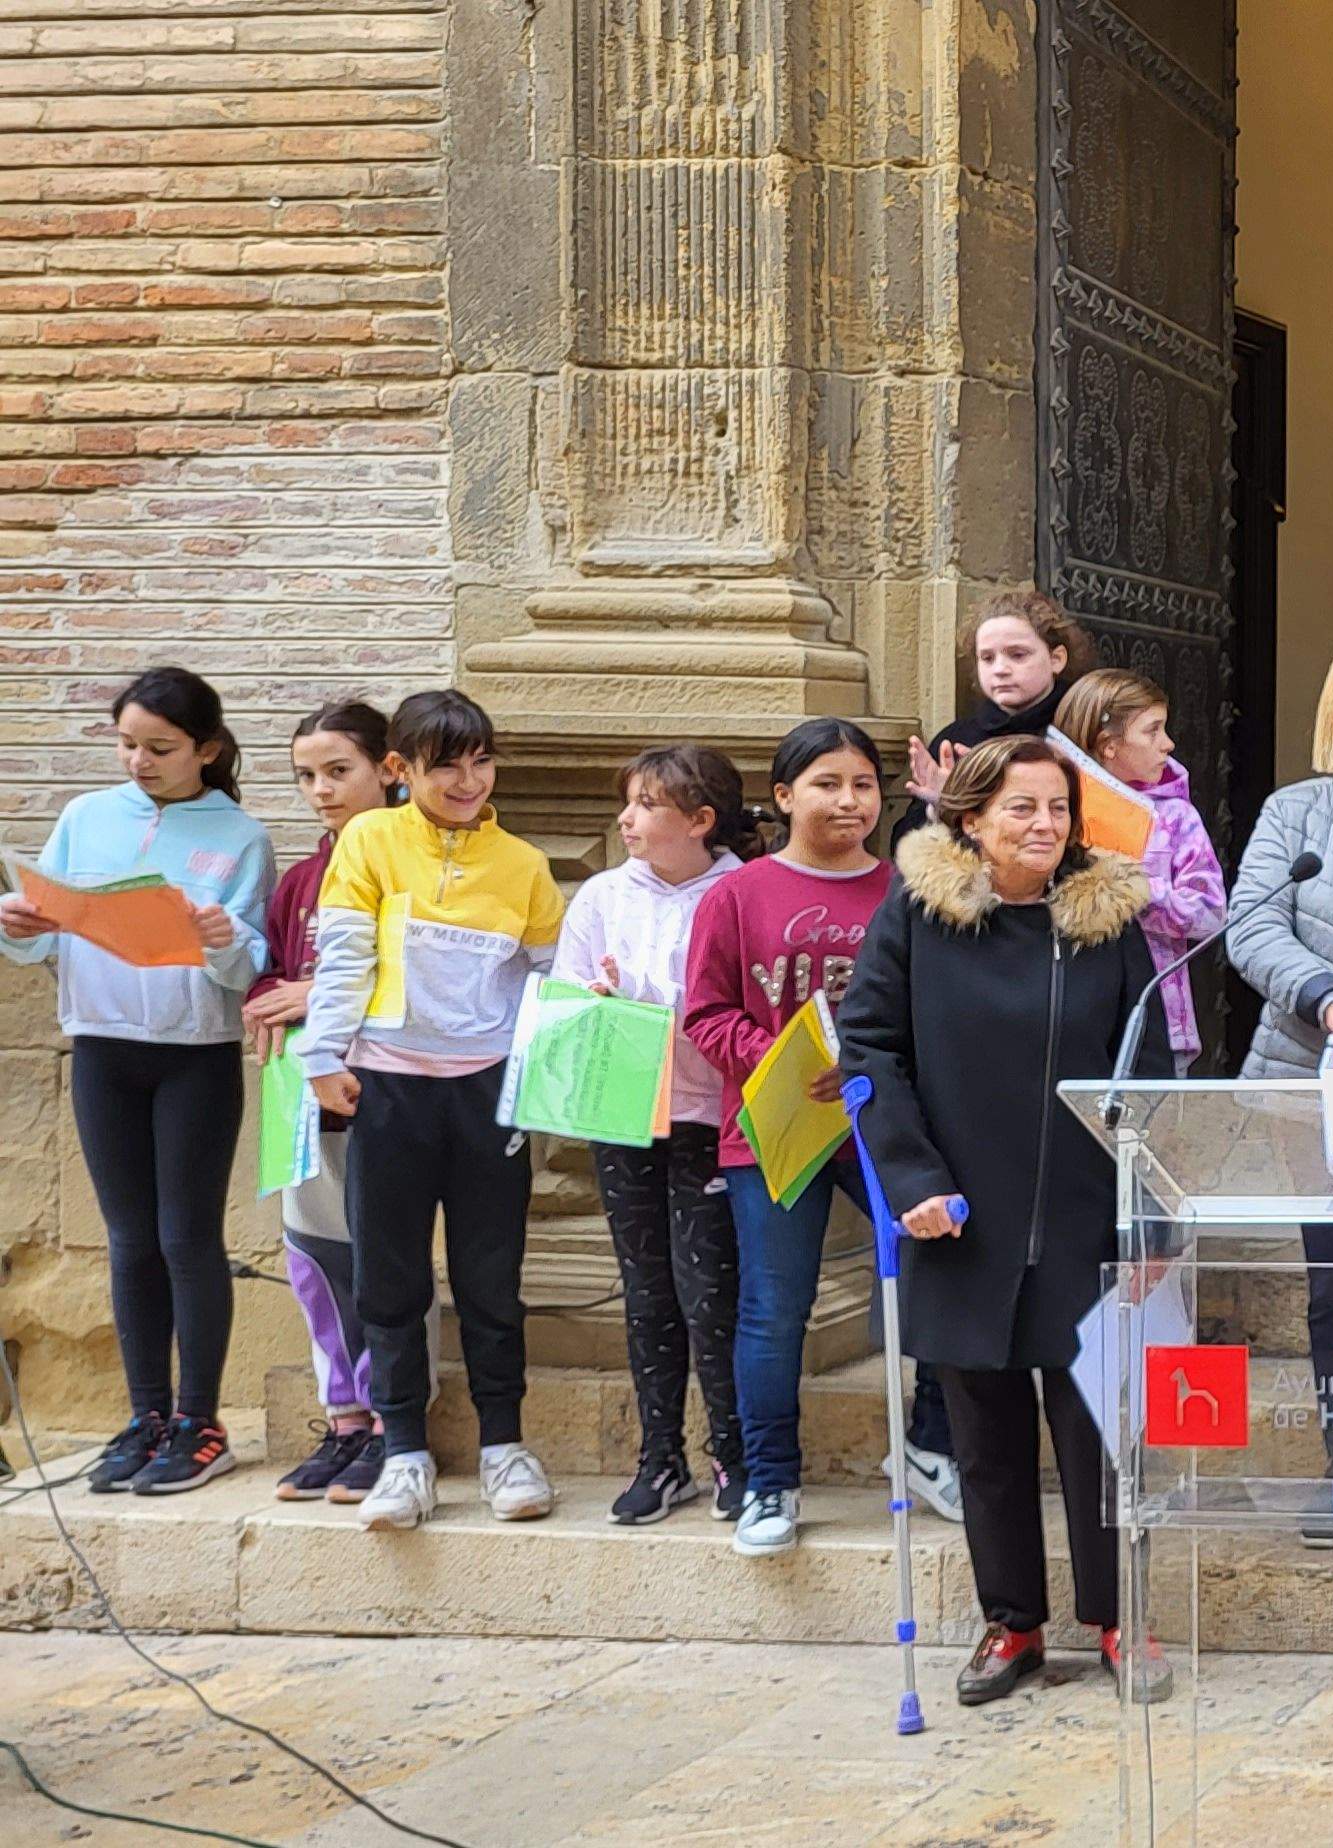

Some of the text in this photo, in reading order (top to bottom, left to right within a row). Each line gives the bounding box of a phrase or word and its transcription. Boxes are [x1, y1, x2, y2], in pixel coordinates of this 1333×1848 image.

[783, 904, 866, 945] Goo
[751, 952, 856, 1008] VIB
[1273, 1403, 1308, 1430] de
